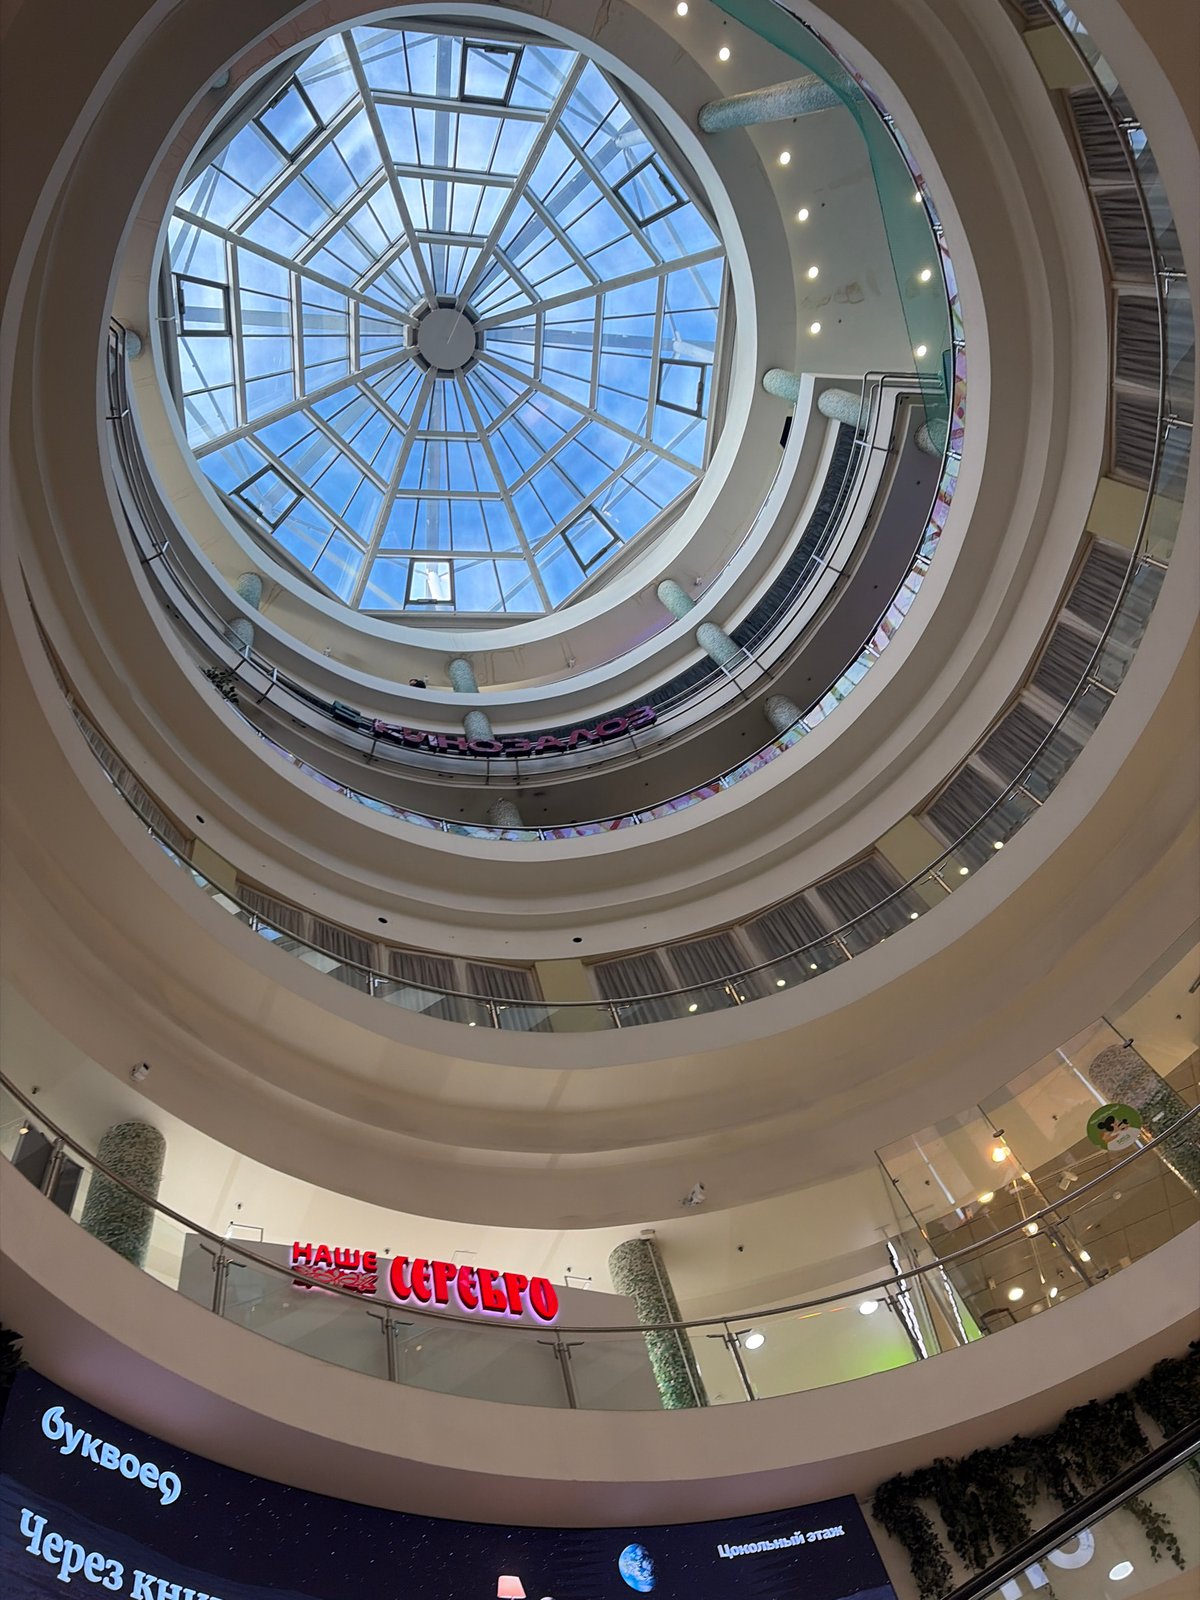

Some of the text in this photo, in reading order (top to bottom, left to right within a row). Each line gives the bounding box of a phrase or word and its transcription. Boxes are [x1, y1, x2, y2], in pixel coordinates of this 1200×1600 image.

[292, 1241, 560, 1321] НАШЕ СЕРЕБРО
[41, 1406, 182, 1506] буквоед
[20, 1507, 124, 1591] Через
[717, 1525, 846, 1559] Цокольный этаж
